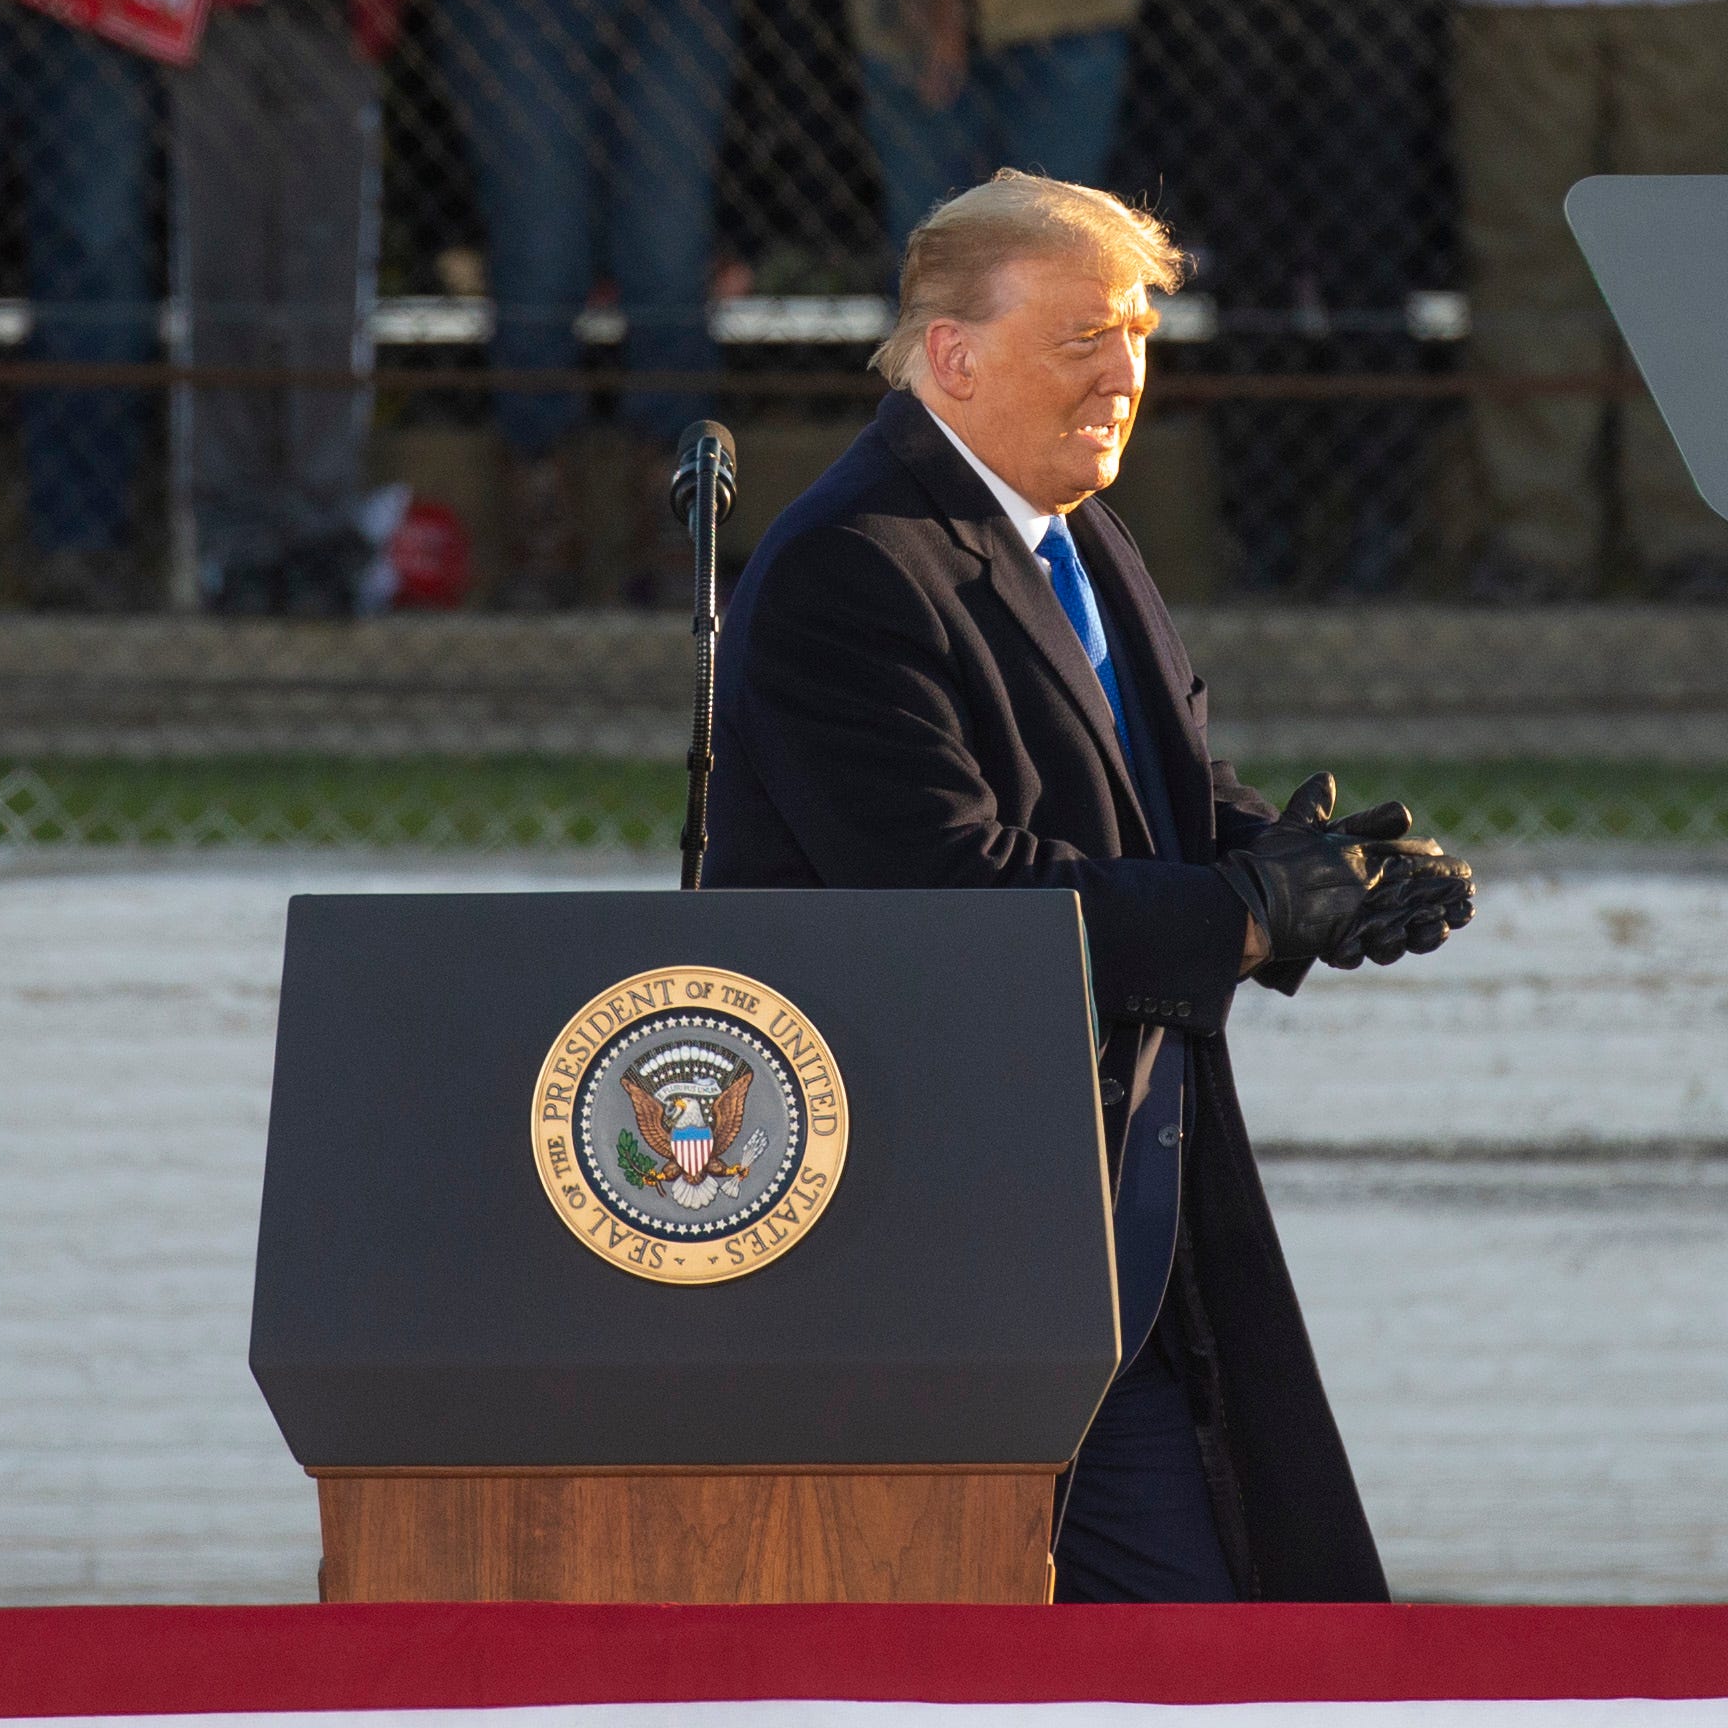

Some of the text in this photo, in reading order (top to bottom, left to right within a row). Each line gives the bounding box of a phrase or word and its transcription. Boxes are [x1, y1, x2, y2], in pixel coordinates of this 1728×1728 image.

[542, 979, 838, 1269] SEAL OF THE PRESIDENT OF THE UNITED STATES
